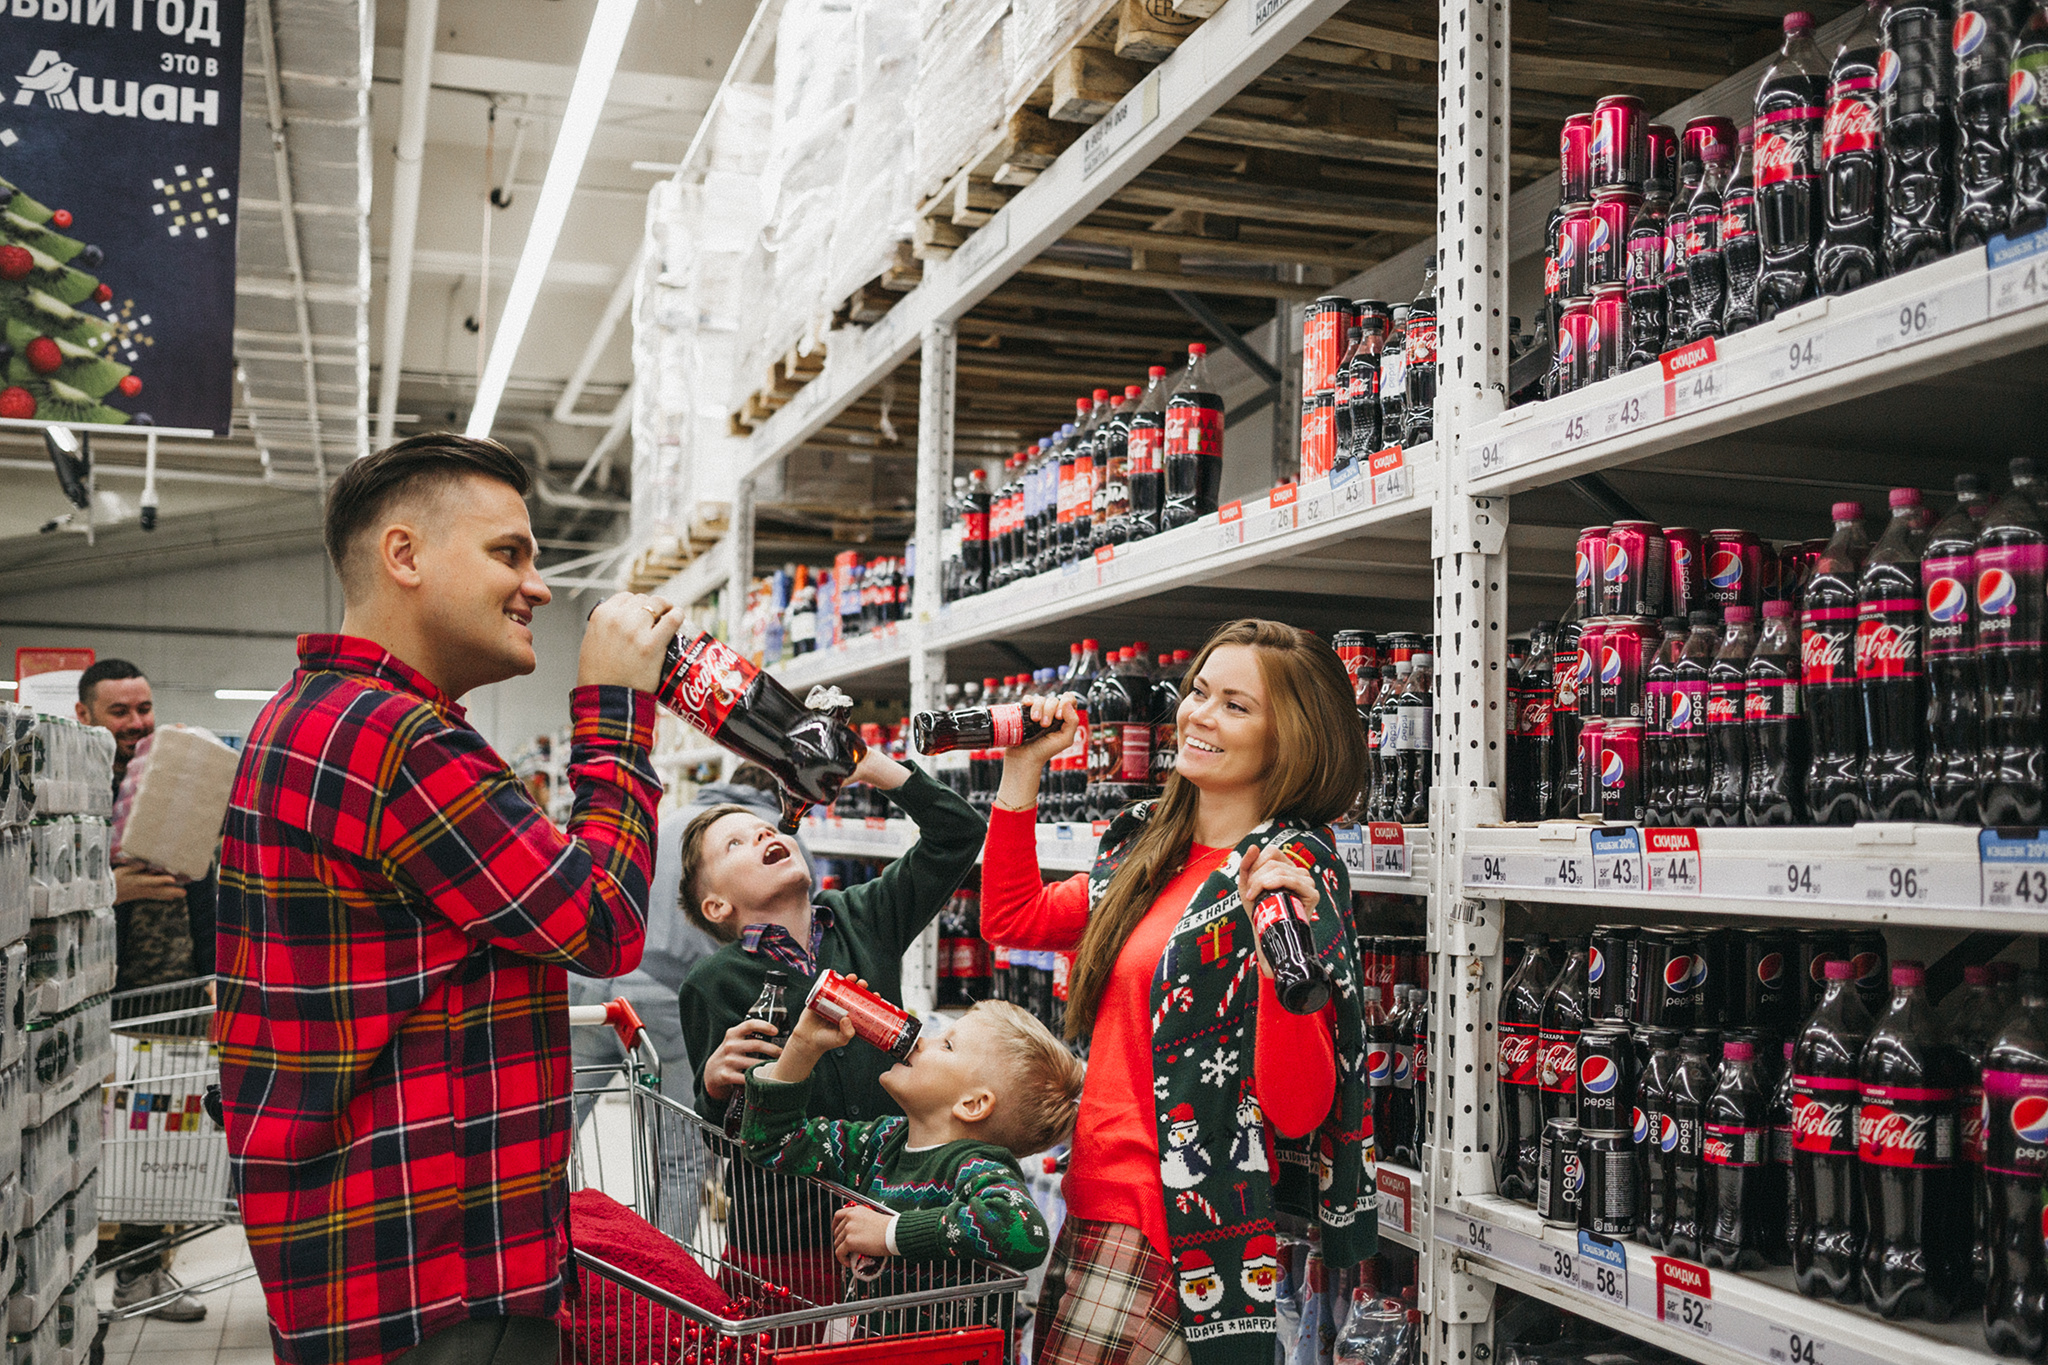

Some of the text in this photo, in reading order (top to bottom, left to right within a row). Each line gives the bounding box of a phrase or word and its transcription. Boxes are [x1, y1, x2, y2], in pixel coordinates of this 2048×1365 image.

[132, 0, 221, 47] ГОД
[14, 49, 220, 126] Ашан
[1561, 153, 1569, 186] pepsi
[1676, 233, 1686, 266] pepsi
[1635, 247, 1645, 280] pepsi
[1900, 302, 1927, 336] 96
[1670, 346, 1709, 372] СКИДКА
[1789, 338, 1813, 370] 94
[1693, 374, 1715, 399] 44
[1620, 398, 1640, 424] 43
[1565, 416, 1583, 441] 45
[1373, 456, 1398, 470] СКИДКА
[1482, 443, 1499, 468] 94
[1273, 489, 1293, 502] СКИДКА
[1387, 474, 1400, 495] 44
[1277, 510, 1288, 528] 26
[1307, 500, 1319, 520] 52
[1678, 566, 1692, 600] pepsi
[1929, 624, 1963, 638] pepsi
[1979, 616, 2012, 633] pepsi
[677, 661, 690, 678] БЕЗ
[1647, 691, 1655, 725] pepsi
[1691, 691, 1704, 726] pepsi
[1375, 827, 1399, 839] СКИДКА
[1596, 838, 1636, 851] КЭШБЭК 20%
[1653, 835, 1691, 851] СКИДКА
[1345, 847, 1359, 868] 43
[1385, 848, 1398, 869] 44
[1484, 857, 1500, 880] 94
[1668, 857, 1689, 884] 44
[1559, 859, 1583, 884] 45 95
[1612, 858, 1632, 884] 43
[1788, 864, 1811, 893] 94
[1889, 867, 1917, 898] 96
[2016, 869, 2048, 904] 43
[1583, 1096, 1615, 1108] pepsi
[1649, 1111, 1659, 1145] pepsi
[1679, 1118, 1690, 1154] pepsi
[1381, 1175, 1405, 1192] СКИДКА
[1385, 1200, 1399, 1220] 44
[1469, 1222, 1485, 1248] 94
[1554, 1251, 1571, 1278] 39
[1605, 1248, 1622, 1265] 20%
[1597, 1267, 1624, 1301] 58 65
[1664, 1262, 1702, 1288] СКИДКА
[1683, 1296, 1703, 1328] 52
[1703, 1321, 1712, 1332] 70
[1790, 1334, 1815, 1365] 94
